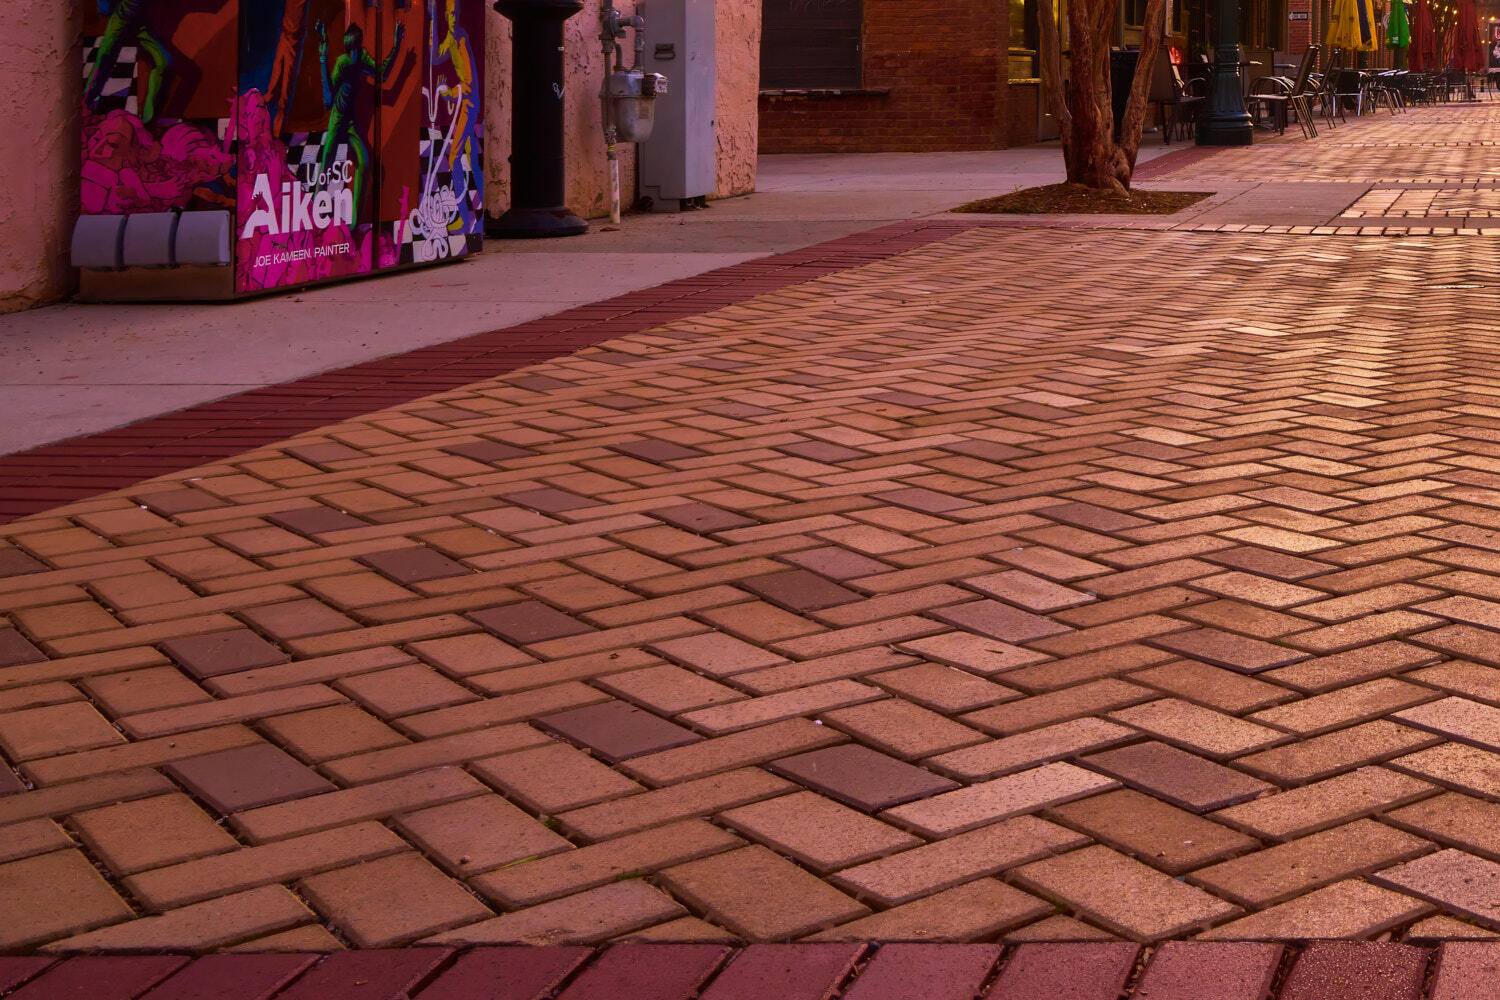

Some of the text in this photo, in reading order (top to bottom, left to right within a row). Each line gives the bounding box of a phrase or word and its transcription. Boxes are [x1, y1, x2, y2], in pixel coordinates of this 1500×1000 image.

[240, 173, 353, 239] Aiken
[253, 255, 272, 268] JOE
[314, 242, 350, 258] PAINTER
